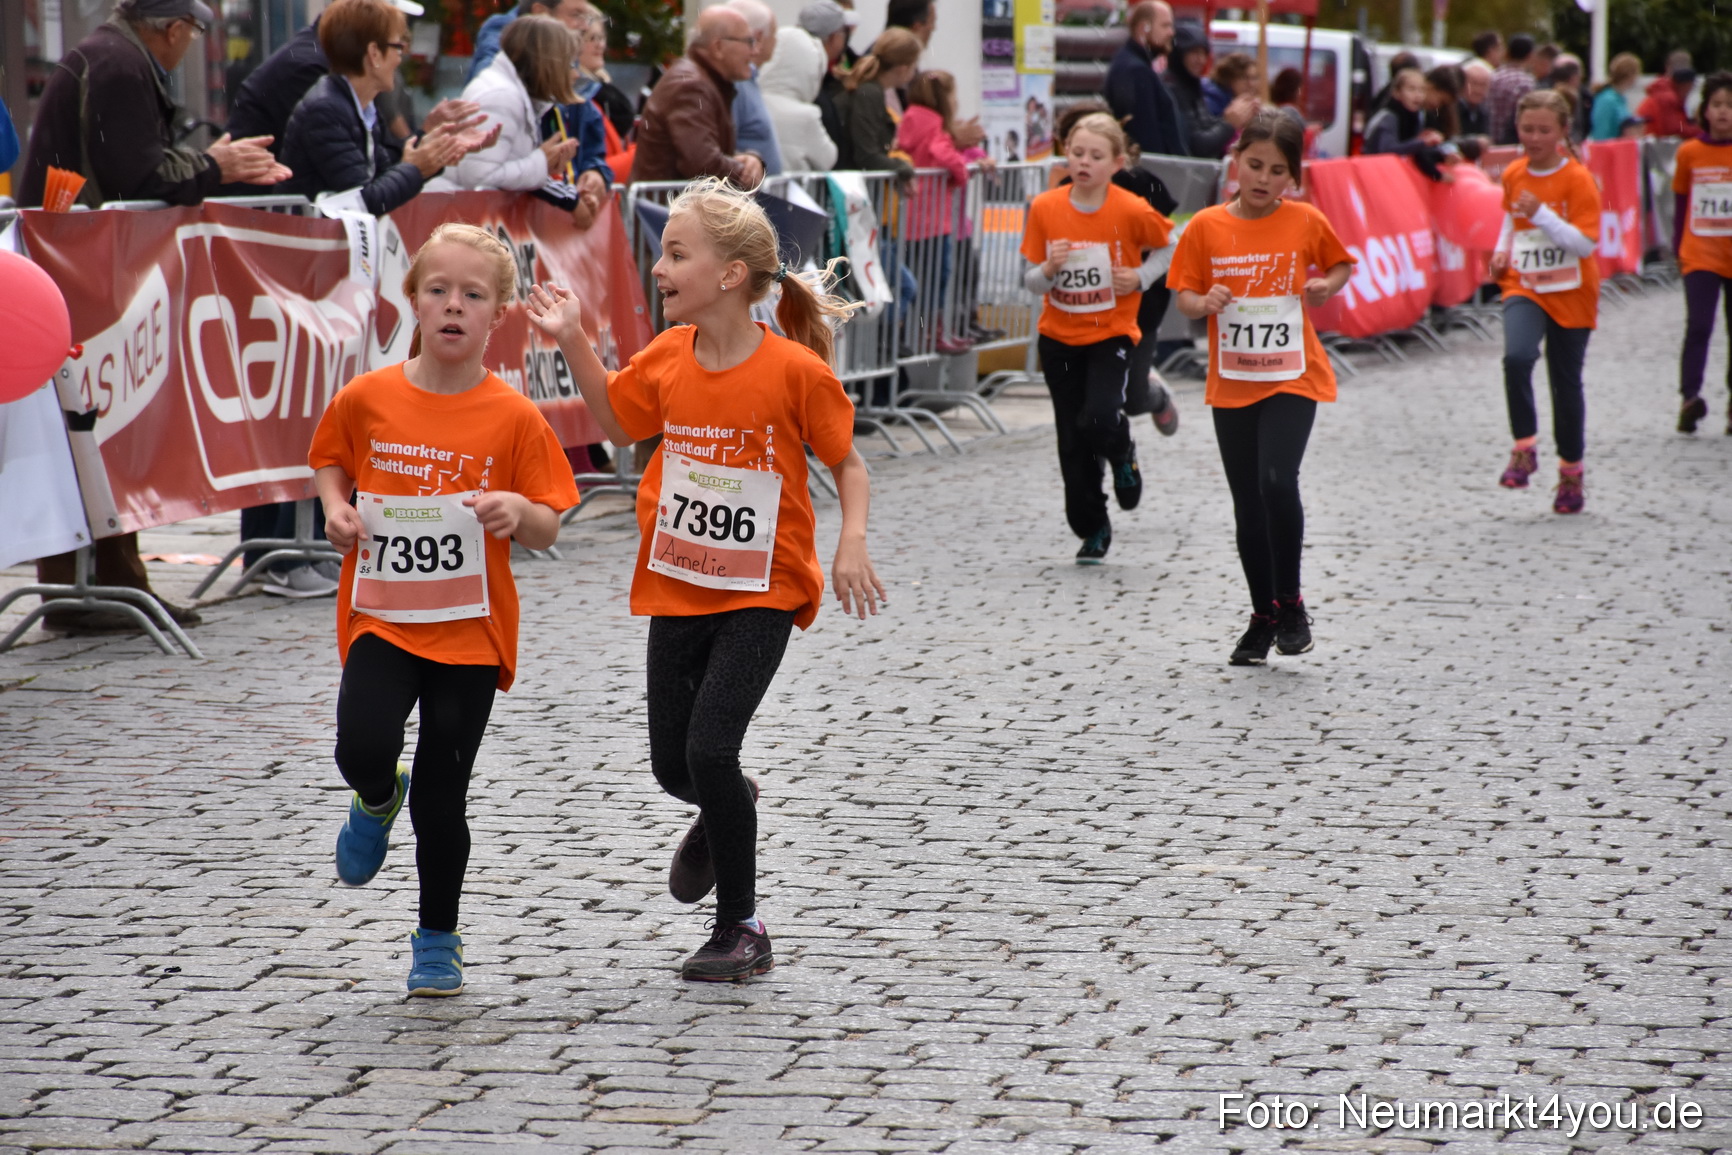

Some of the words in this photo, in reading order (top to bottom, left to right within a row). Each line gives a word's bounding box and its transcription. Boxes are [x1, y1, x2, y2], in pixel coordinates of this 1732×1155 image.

[1700, 198, 1732, 216] 714
[1211, 253, 1271, 266] Neumarkter
[1521, 247, 1566, 269] 7197
[1056, 267, 1102, 289] 256
[1212, 265, 1257, 278] Stadtlauf
[1228, 323, 1290, 348] 7173
[1237, 356, 1284, 367] Anna-Lena
[664, 420, 736, 439] Neumarkter
[370, 439, 454, 462] Neumarkter
[664, 438, 717, 460] Stadtlauf
[370, 456, 433, 480] Stadtlauf
[698, 473, 743, 491] BOCK
[395, 507, 443, 519] BOCK
[672, 493, 756, 543] 7396
[372, 533, 464, 574] 7393
[659, 538, 727, 578] Amelie
